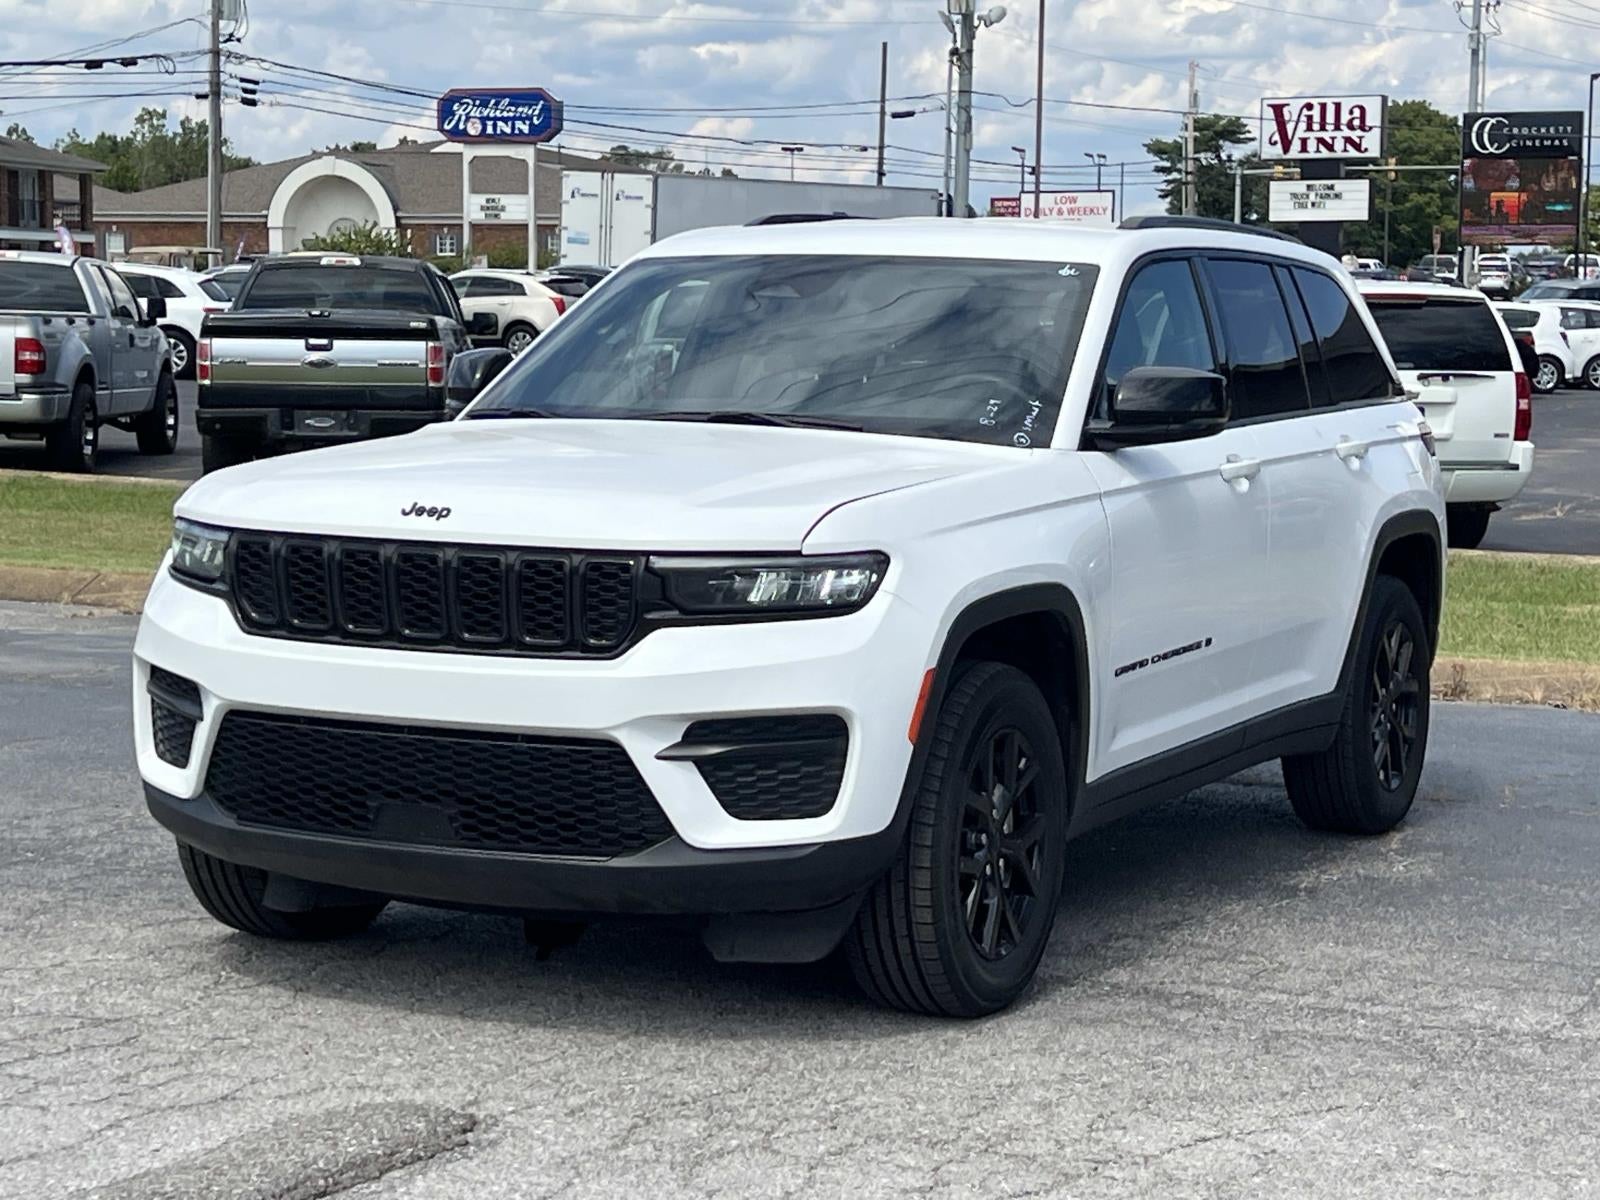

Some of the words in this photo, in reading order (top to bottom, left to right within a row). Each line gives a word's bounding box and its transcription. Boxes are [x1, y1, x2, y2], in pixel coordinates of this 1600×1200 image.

[444, 98, 544, 130] Richland
[486, 120, 530, 134] INN
[1267, 102, 1373, 155] Villa
[1503, 126, 1572, 135] CROCKETT
[1298, 136, 1368, 153] INN
[1511, 139, 1569, 147] CINEMAS
[1306, 184, 1335, 192] WELCOME
[1054, 195, 1078, 206] LOW
[1315, 192, 1342, 200] PARKING
[1024, 207, 1054, 217] DILY
[1056, 207, 1064, 216] &
[1067, 206, 1108, 216] WEEKLY
[401, 501, 452, 521] Jeep
[1114, 658, 1149, 678] GRAND
[1151, 640, 1203, 665] CHEROKEE
